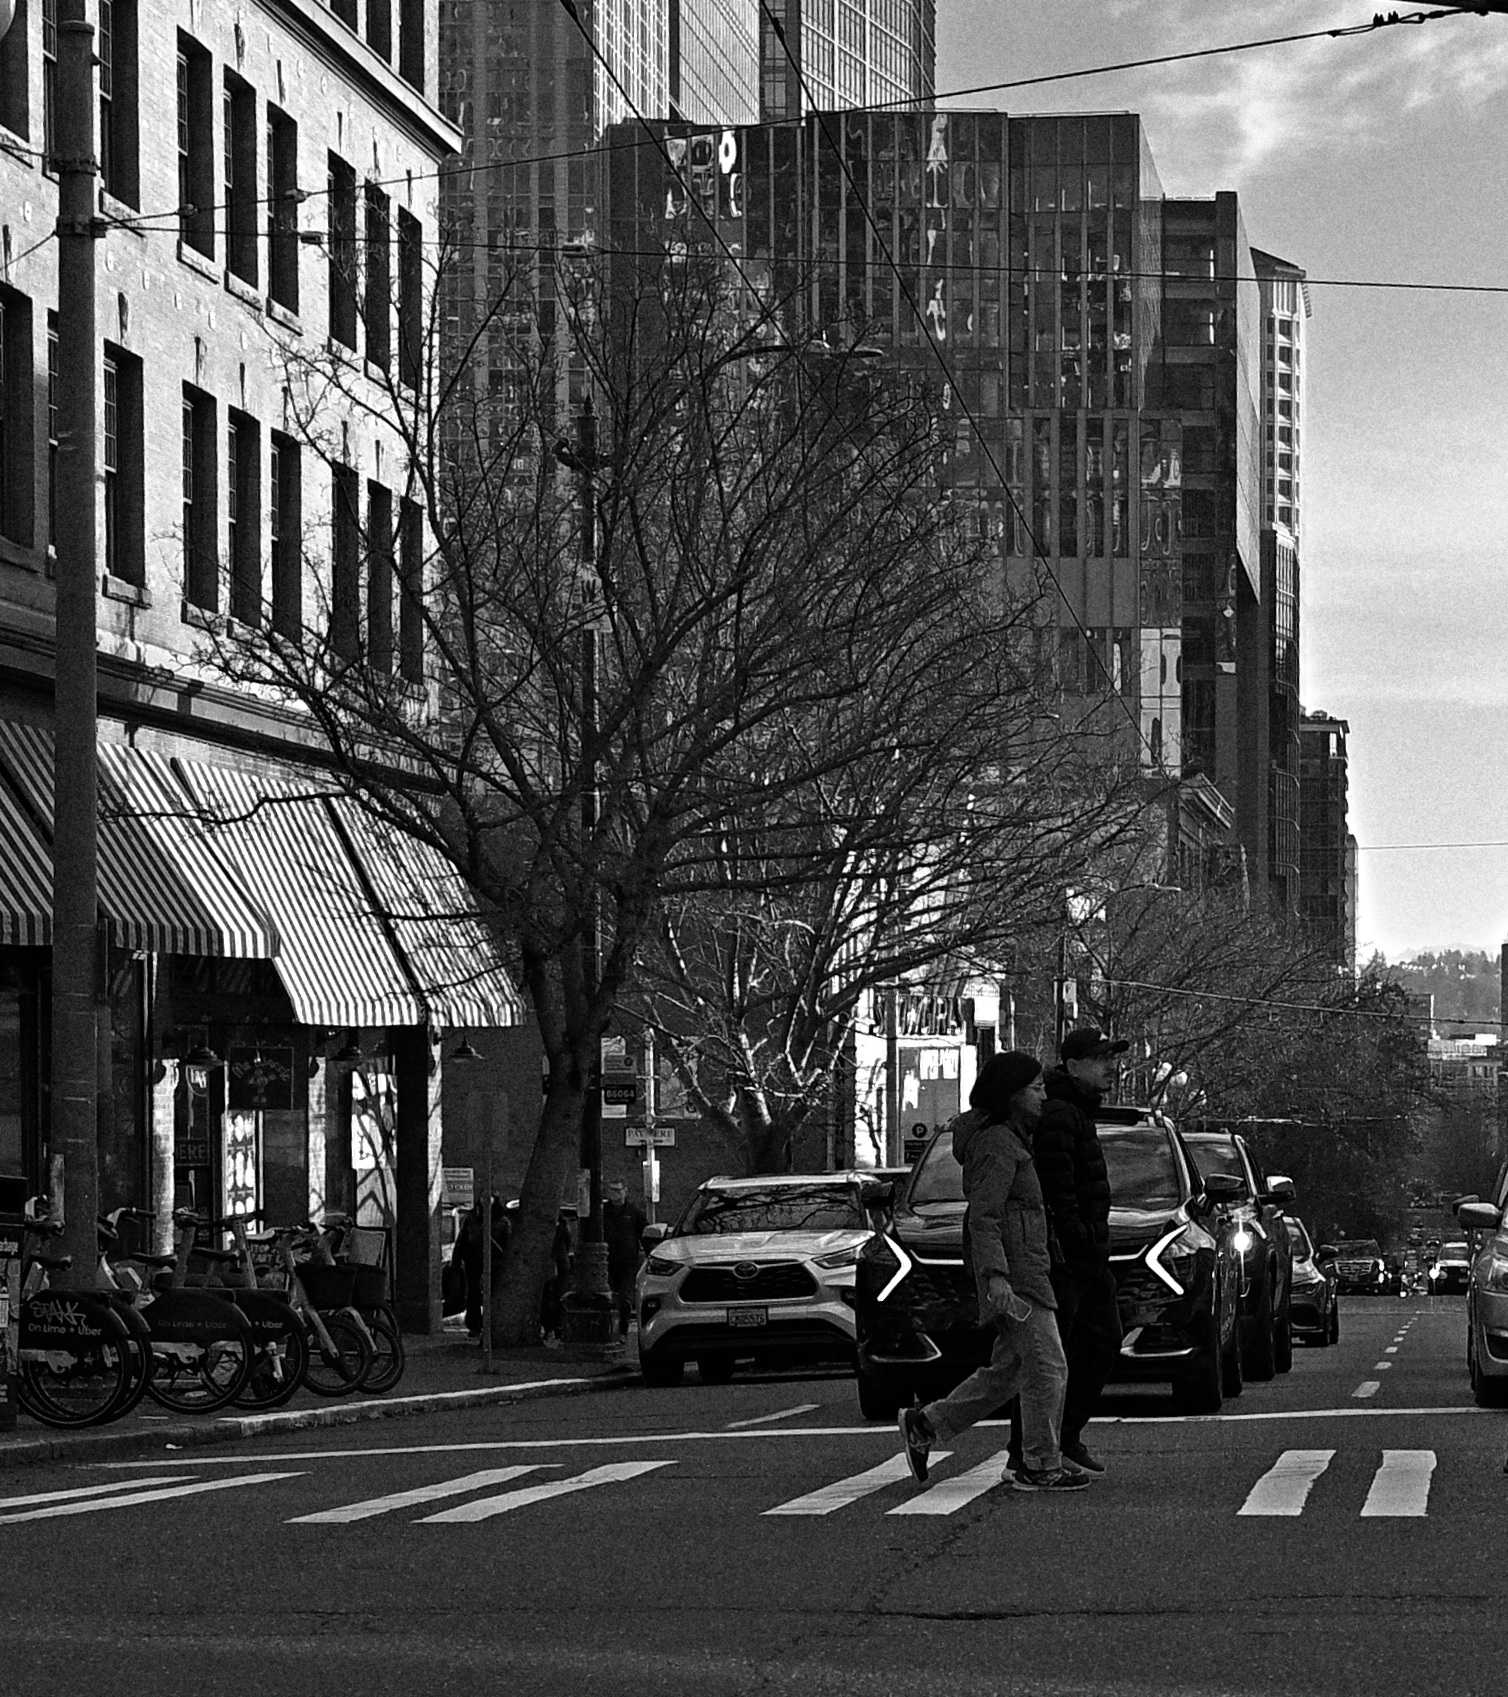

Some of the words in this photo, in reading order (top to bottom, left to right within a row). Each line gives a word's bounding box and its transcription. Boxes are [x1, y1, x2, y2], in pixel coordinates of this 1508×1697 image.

[628, 1129, 644, 1138] PAY
[28, 1322, 42, 1332] On
[43, 1323, 67, 1334] Lime
[78, 1325, 102, 1336] Uber
[261, 1320, 284, 1330] Uber
